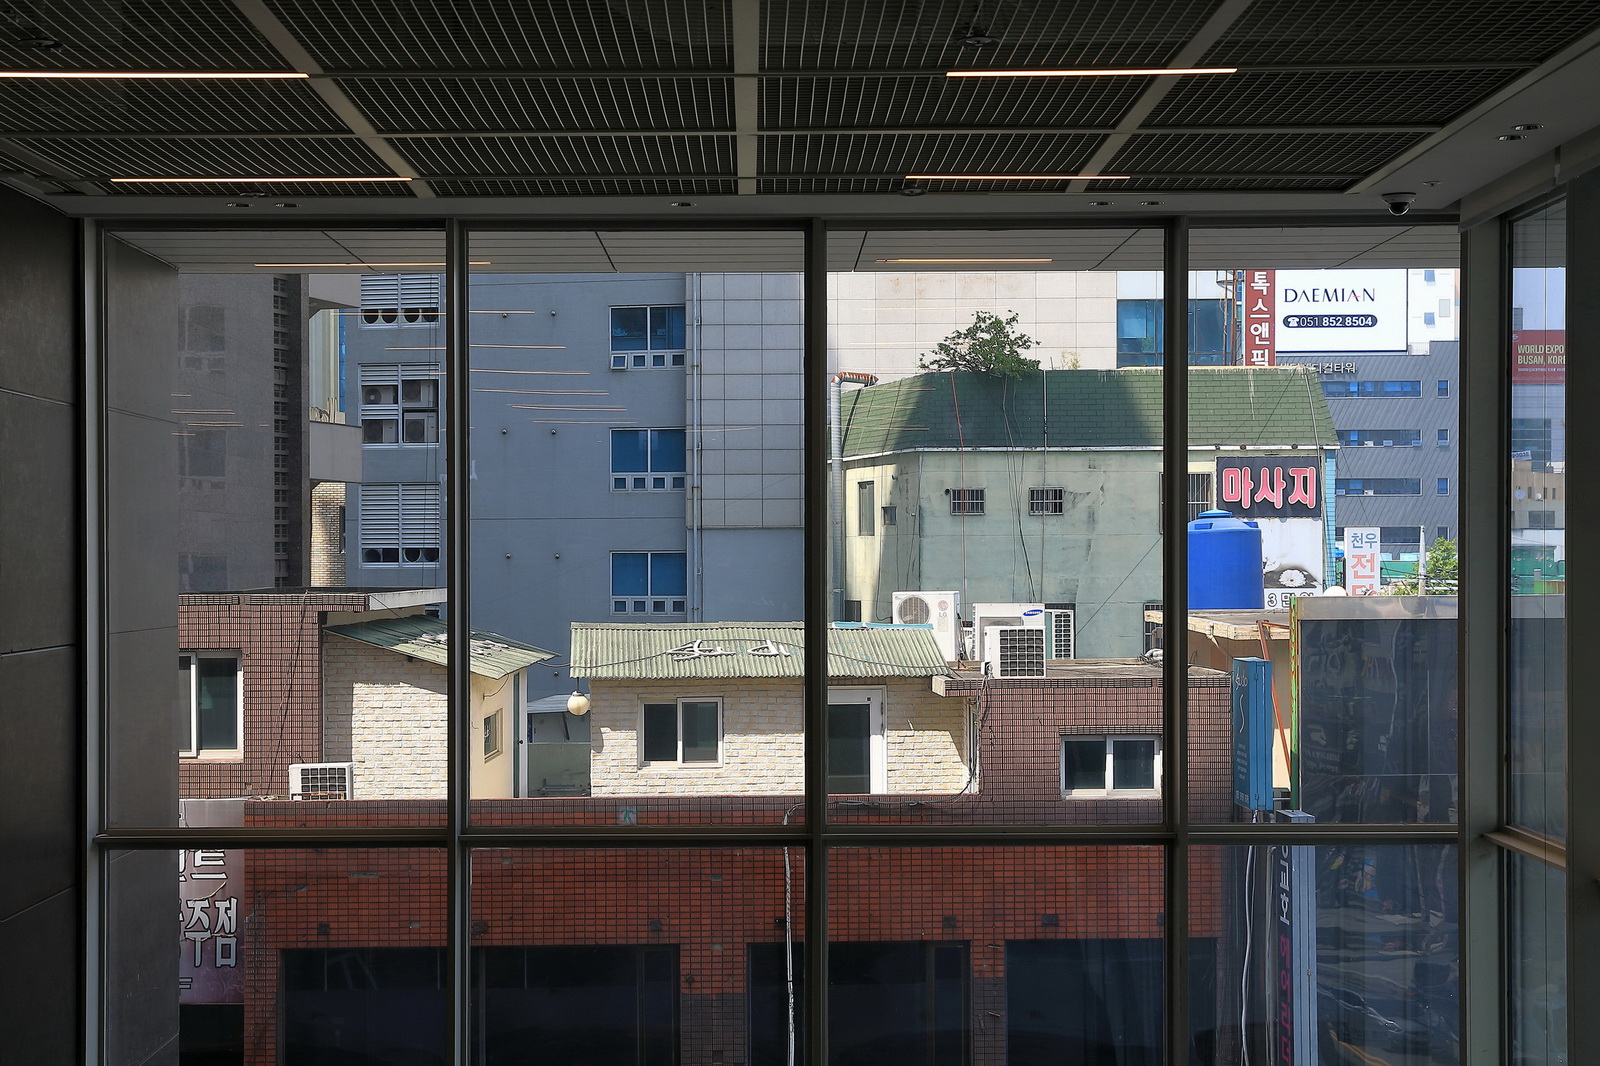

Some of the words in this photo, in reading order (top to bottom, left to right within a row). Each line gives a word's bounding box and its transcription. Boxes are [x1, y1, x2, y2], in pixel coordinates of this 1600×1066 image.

[1284, 288, 1375, 302] DAEMIAN
[1300, 316, 1373, 327] 051.852.8504
[1517, 344, 1544, 354] WORLD
[1545, 344, 1565, 354] EXPO
[1517, 355, 1545, 367] BUSAN,
[1223, 466, 1316, 509] 마사지
[1351, 532, 1378, 549] 천우
